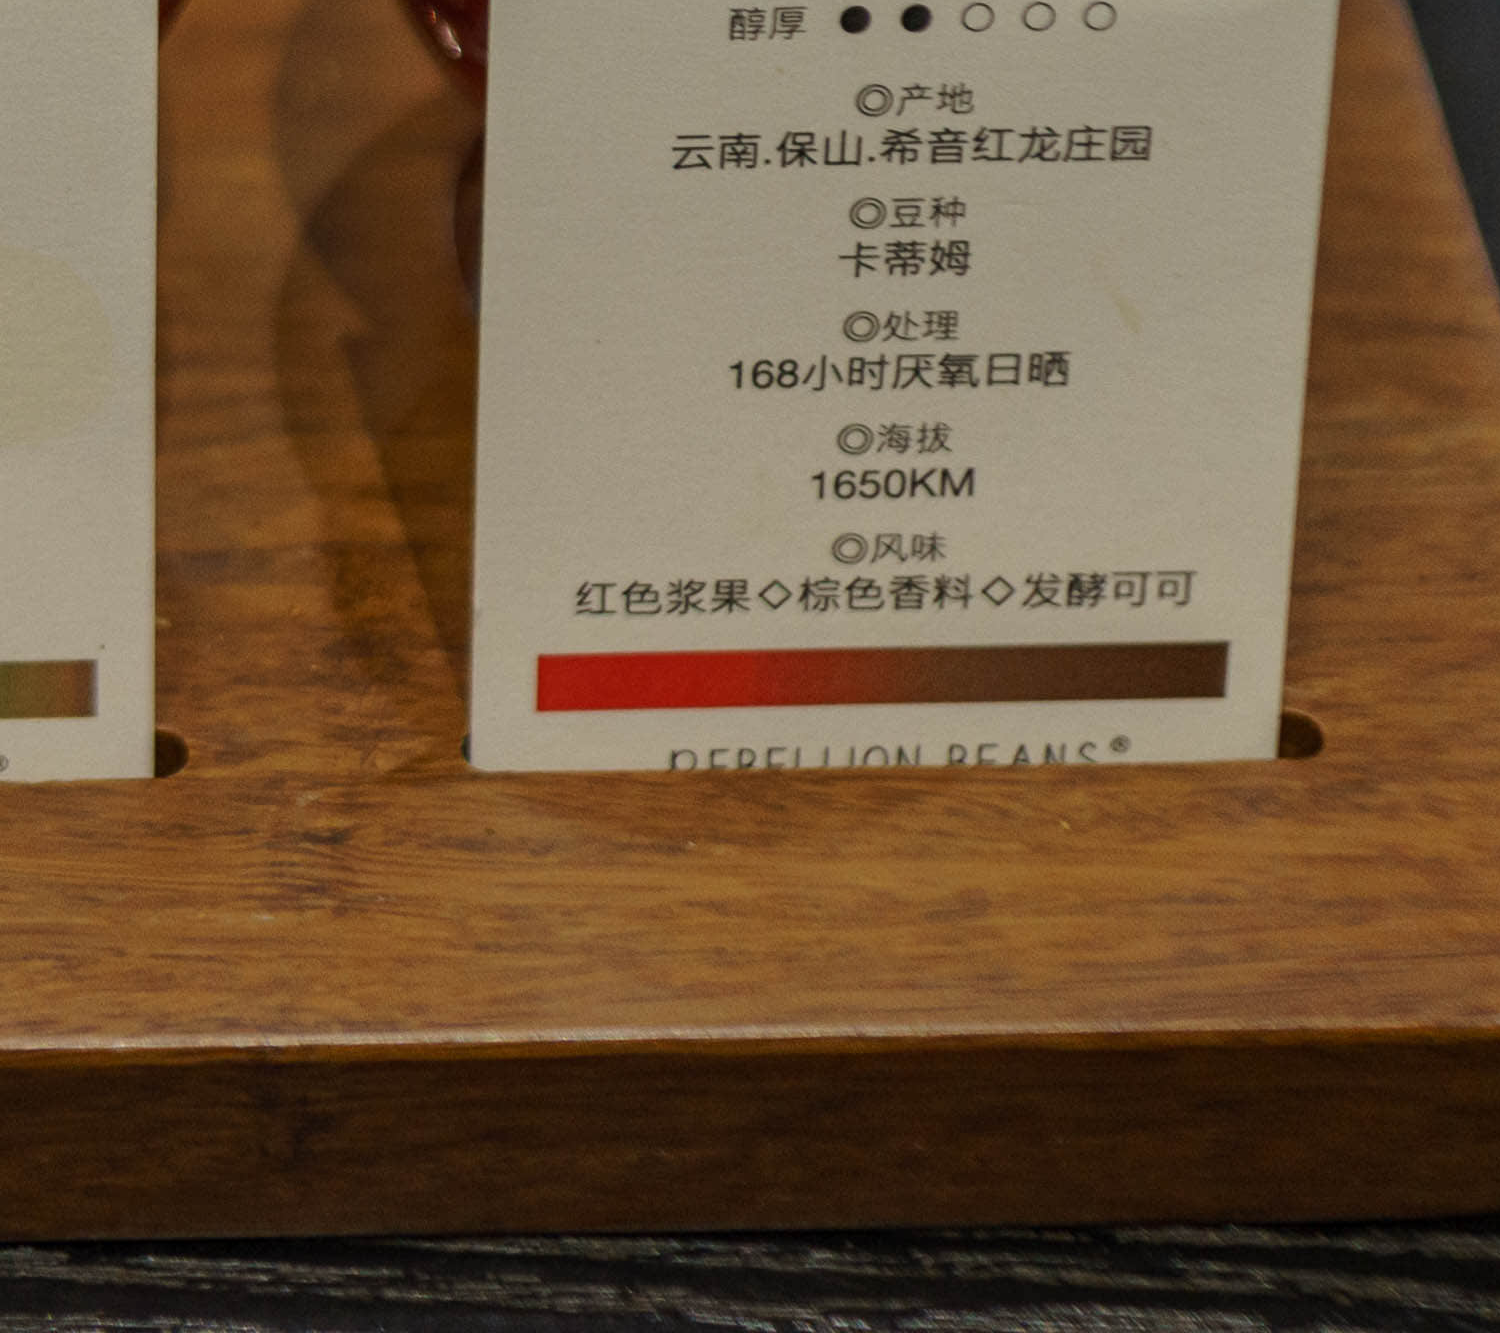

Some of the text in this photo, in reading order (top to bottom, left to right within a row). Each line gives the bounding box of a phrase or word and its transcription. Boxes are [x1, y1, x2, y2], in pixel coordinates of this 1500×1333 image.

[728, 6, 805, 42] 醇厚
[896, 83, 975, 117] 产地
[889, 196, 966, 229] 豆种
[839, 239, 971, 278] 卡蒂姆
[882, 310, 959, 342] 处理
[729, 350, 1069, 392] 168小时厌氧日晒
[876, 422, 951, 455] 海拔
[811, 467, 975, 501] 1650KM
[870, 532, 945, 564] 风味
[575, 570, 1194, 616] 红色浆果 棕色香料 发酵可可
